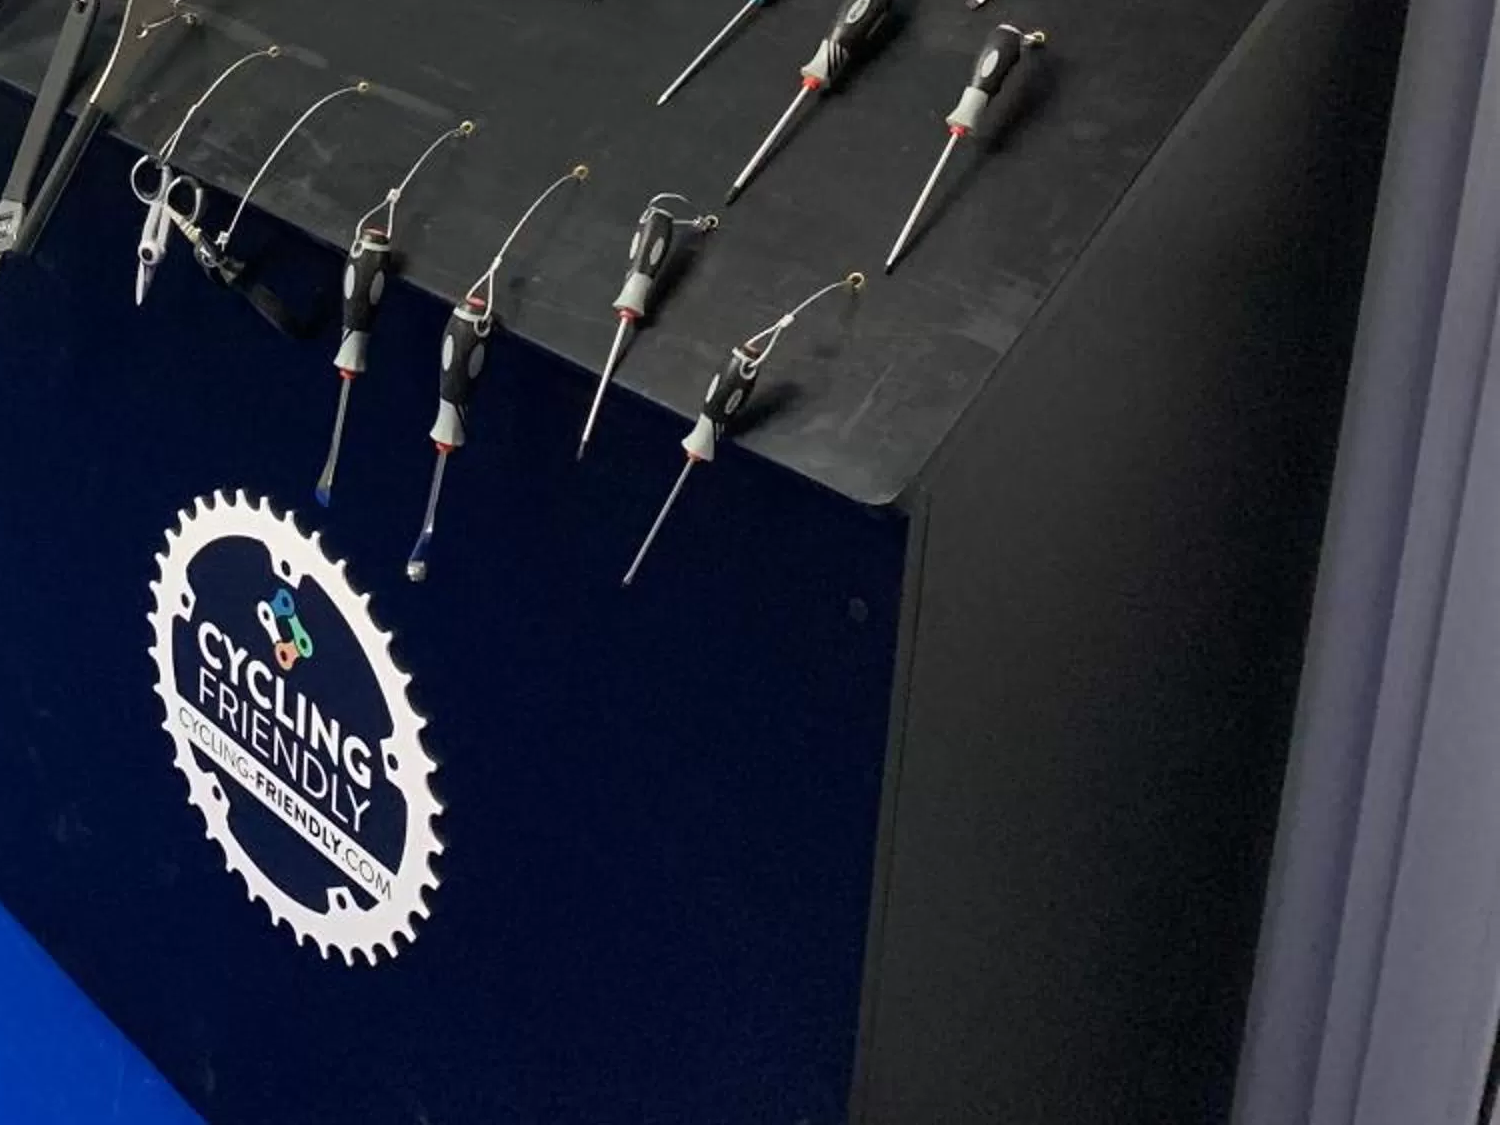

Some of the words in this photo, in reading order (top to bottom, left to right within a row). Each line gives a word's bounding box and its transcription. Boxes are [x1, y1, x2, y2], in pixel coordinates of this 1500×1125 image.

[198, 621, 371, 789] CYCLING
[200, 667, 370, 832] FRIENDLY
[179, 706, 391, 900] CYCLING-FRIENDLY.COM
